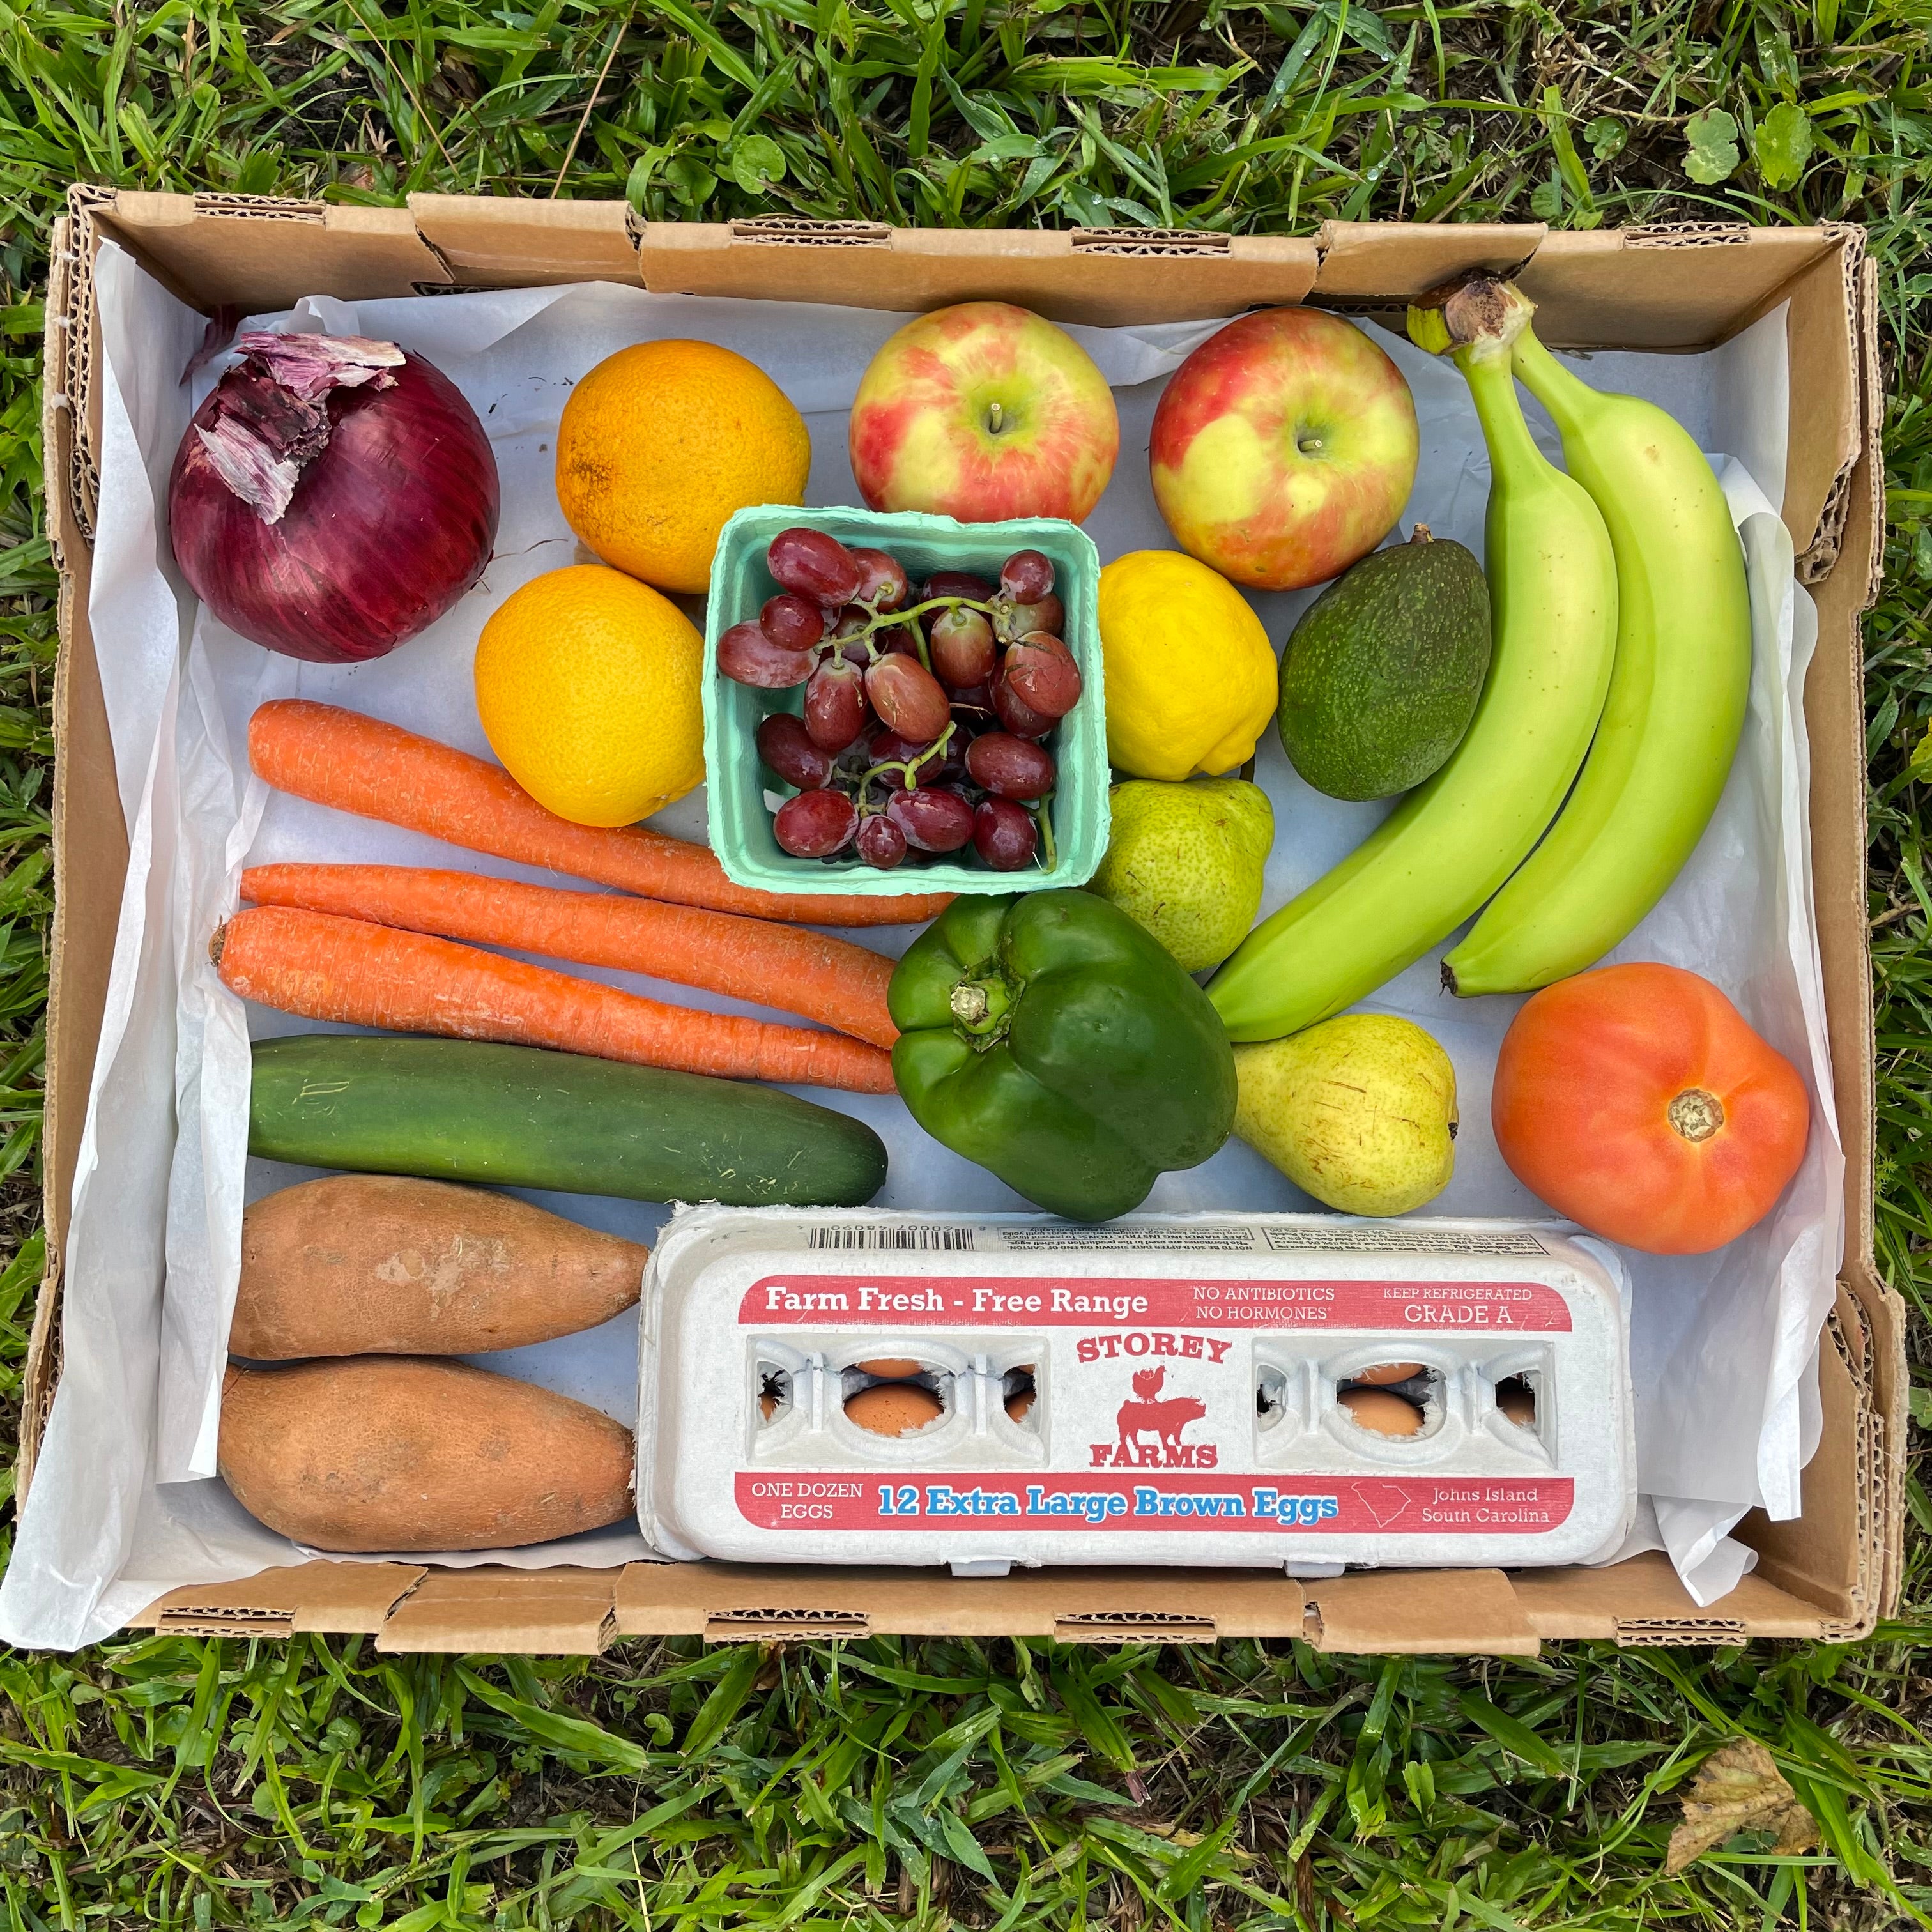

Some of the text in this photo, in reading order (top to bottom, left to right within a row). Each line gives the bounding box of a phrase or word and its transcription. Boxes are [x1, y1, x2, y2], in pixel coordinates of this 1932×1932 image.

[1194, 1287, 1334, 1300] NO ANTIBIOTICS
[1384, 1288, 1533, 1300] KEEP REFRIGERATED
[766, 1287, 848, 1310] Farm
[858, 1287, 944, 1311] Fresh
[972, 1289, 1041, 1312] Free
[1051, 1289, 1148, 1317] Range
[1197, 1306, 1222, 1319] NO
[1404, 1304, 1513, 1324] GRADE A
[1077, 1333, 1232, 1363] STOREY
[1091, 1443, 1217, 1468] FARMS
[752, 1482, 863, 1497] ONE DOZEN
[1432, 1488, 1538, 1505] Johns Island
[781, 1504, 833, 1519] EGGS
[879, 1486, 1338, 1525] 12 Extra Large Brown Eggs
[1422, 1508, 1550, 1522] South Carolina
